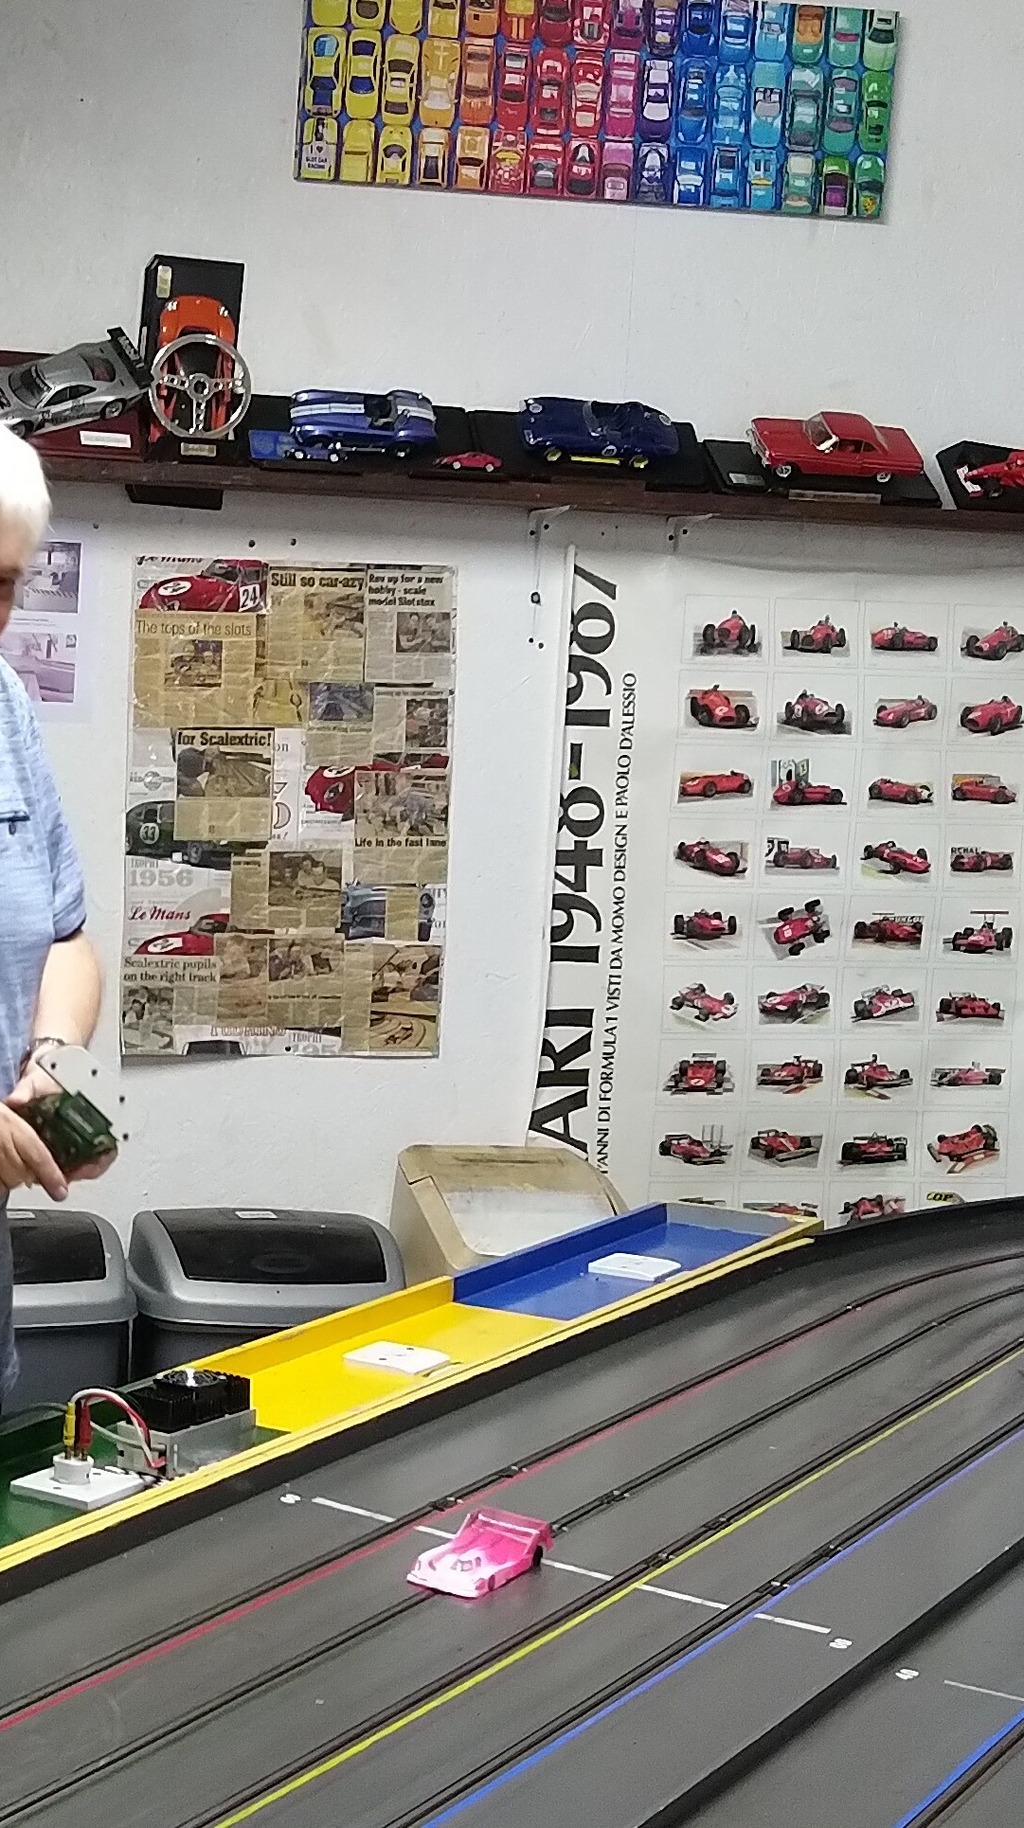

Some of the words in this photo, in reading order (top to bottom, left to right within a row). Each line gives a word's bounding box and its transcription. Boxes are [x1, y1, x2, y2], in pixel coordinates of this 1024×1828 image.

[271, 572, 297, 587] Still
[300, 576, 316, 588] so
[319, 576, 365, 591] car-azy
[369, 573, 386, 584] Rev
[401, 573, 416, 584] for
[241, 586, 258, 609] 24
[136, 619, 158, 635] The
[161, 623, 185, 637] tops
[188, 621, 201, 636] of
[224, 623, 252, 636] slots
[619, 672, 637, 750] D'ALESSIO
[200, 731, 272, 747] Scalextric!
[614, 754, 632, 806] PAOLO
[615, 810, 629, 819] E
[355, 837, 373, 848] Life
[376, 838, 385, 847] in
[387, 837, 402, 847] the
[405, 837, 424, 847] fast
[426, 837, 447, 847] lane
[613, 824, 628, 882] DESIGN
[129, 868, 194, 888] 1956
[150, 905, 192, 921] Mans
[610, 886, 626, 944] MOMO
[124, 956, 181, 970] Scalextric
[183, 958, 218, 971] pupils
[609, 947, 623, 970] DA
[123, 972, 137, 981] on
[140, 971, 157, 981] the
[160, 971, 186, 983] right
[189, 972, 217, 982] track
[605, 974, 622, 1011] VISTI
[599, 1025, 618, 1102] FORMULA
[597, 1105, 611, 1123] DI
